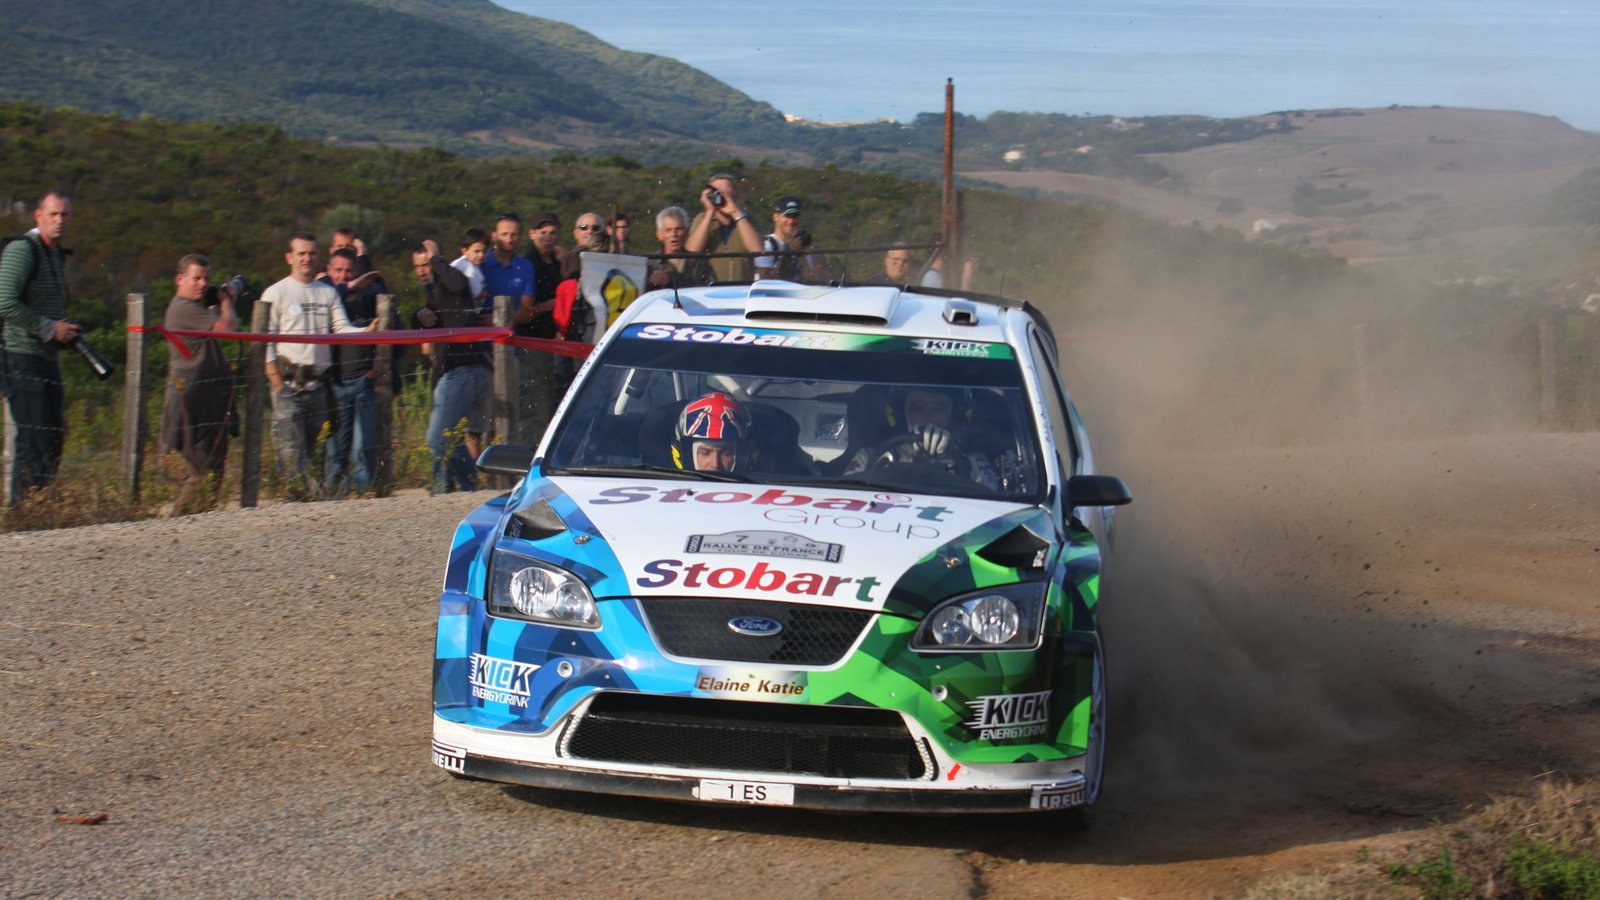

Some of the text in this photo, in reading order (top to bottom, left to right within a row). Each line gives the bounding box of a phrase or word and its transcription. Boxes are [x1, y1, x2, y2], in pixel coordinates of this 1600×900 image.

[637, 325, 834, 348] Stobart
[589, 486, 953, 522] Stobart
[764, 508, 940, 539] Group
[735, 534, 749, 543] 7
[774, 546, 825, 556] FRANCE
[636, 559, 881, 603] Stobart
[740, 619, 770, 631] Ford
[469, 653, 541, 696] KICK
[697, 677, 804, 696] Elaine Katie
[964, 690, 1053, 729] KICK
[431, 750, 465, 773] RELLI
[728, 784, 767, 800] 1 ES
